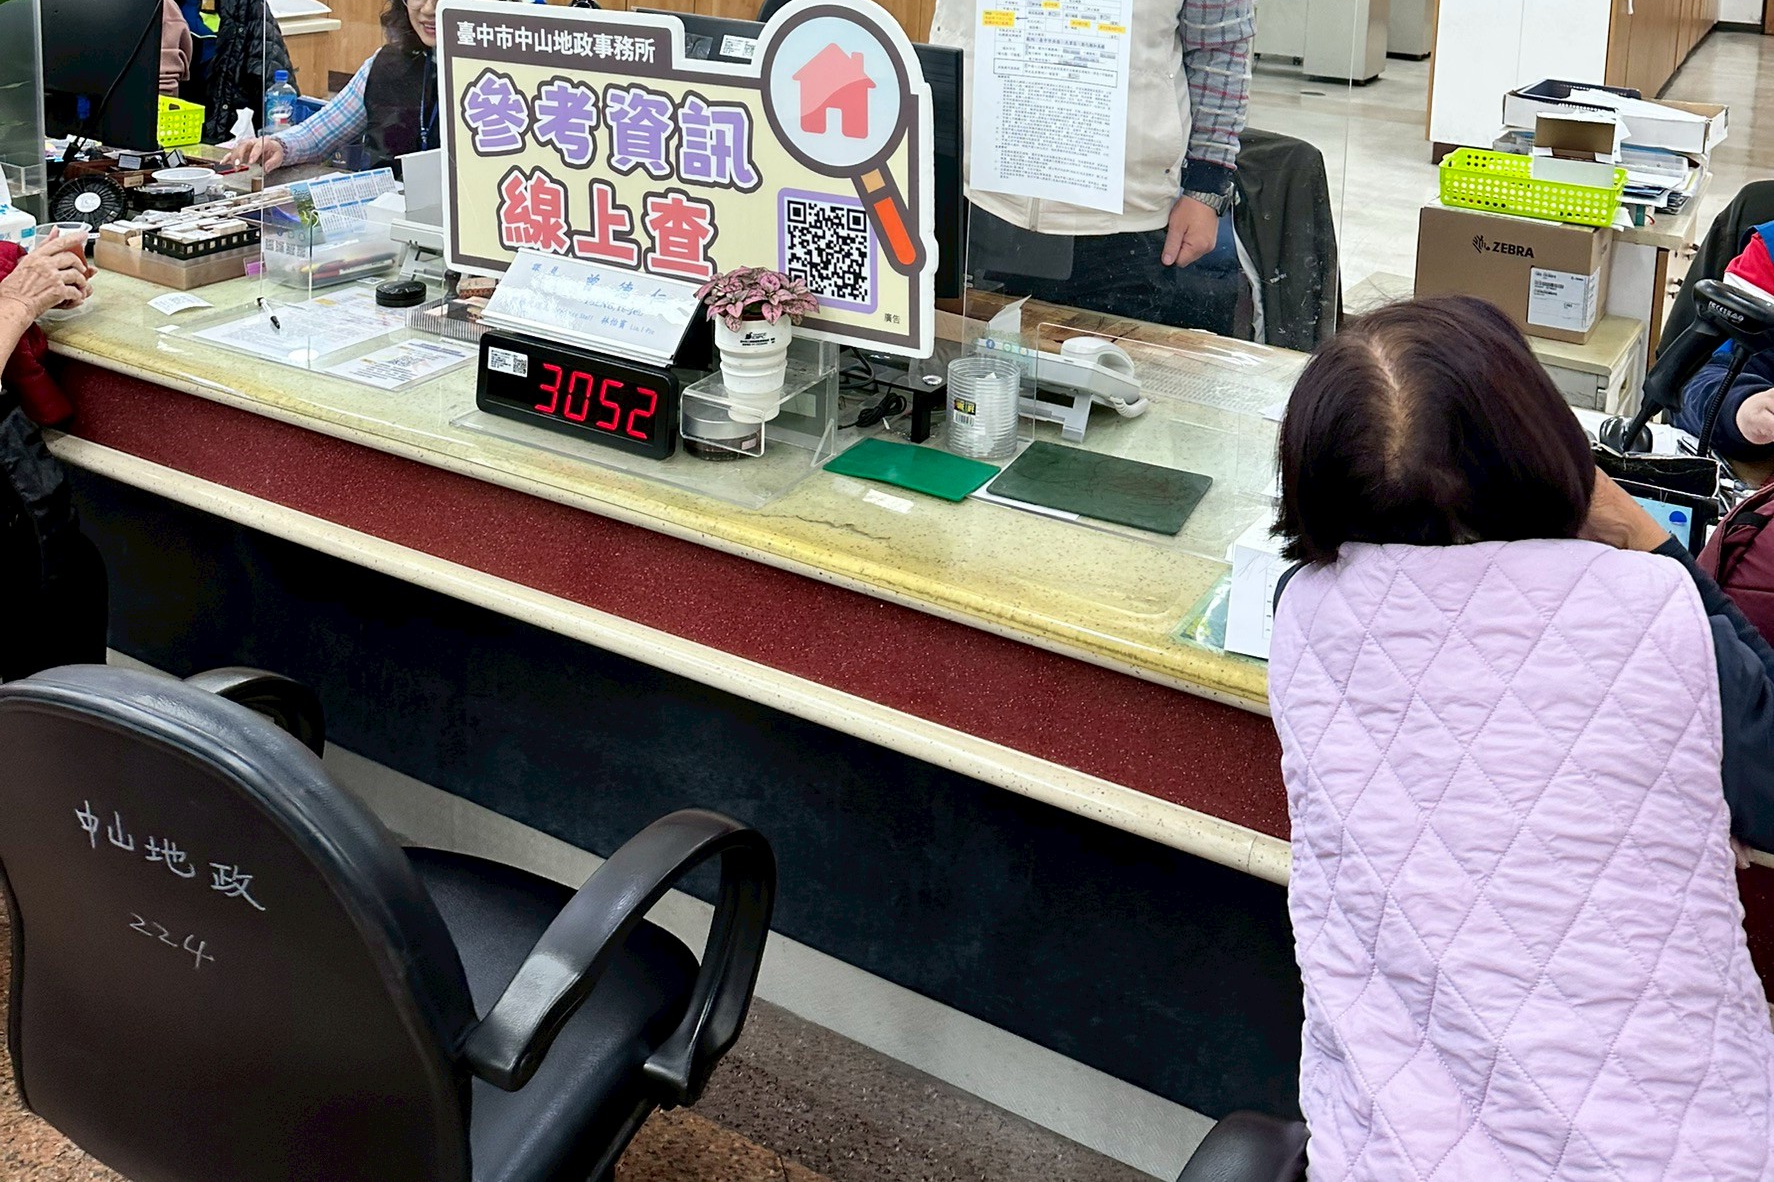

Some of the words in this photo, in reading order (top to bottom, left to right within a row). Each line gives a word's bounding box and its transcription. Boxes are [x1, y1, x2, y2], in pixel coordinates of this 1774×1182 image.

[456, 21, 656, 64] 臺中市中山地政事務所
[463, 72, 758, 190] 參考資訊
[500, 169, 718, 280] 線上查
[1491, 241, 1535, 259] ZEBRA
[534, 362, 657, 439] 3052
[75, 800, 266, 911] 中山地政
[129, 912, 215, 968] 224
